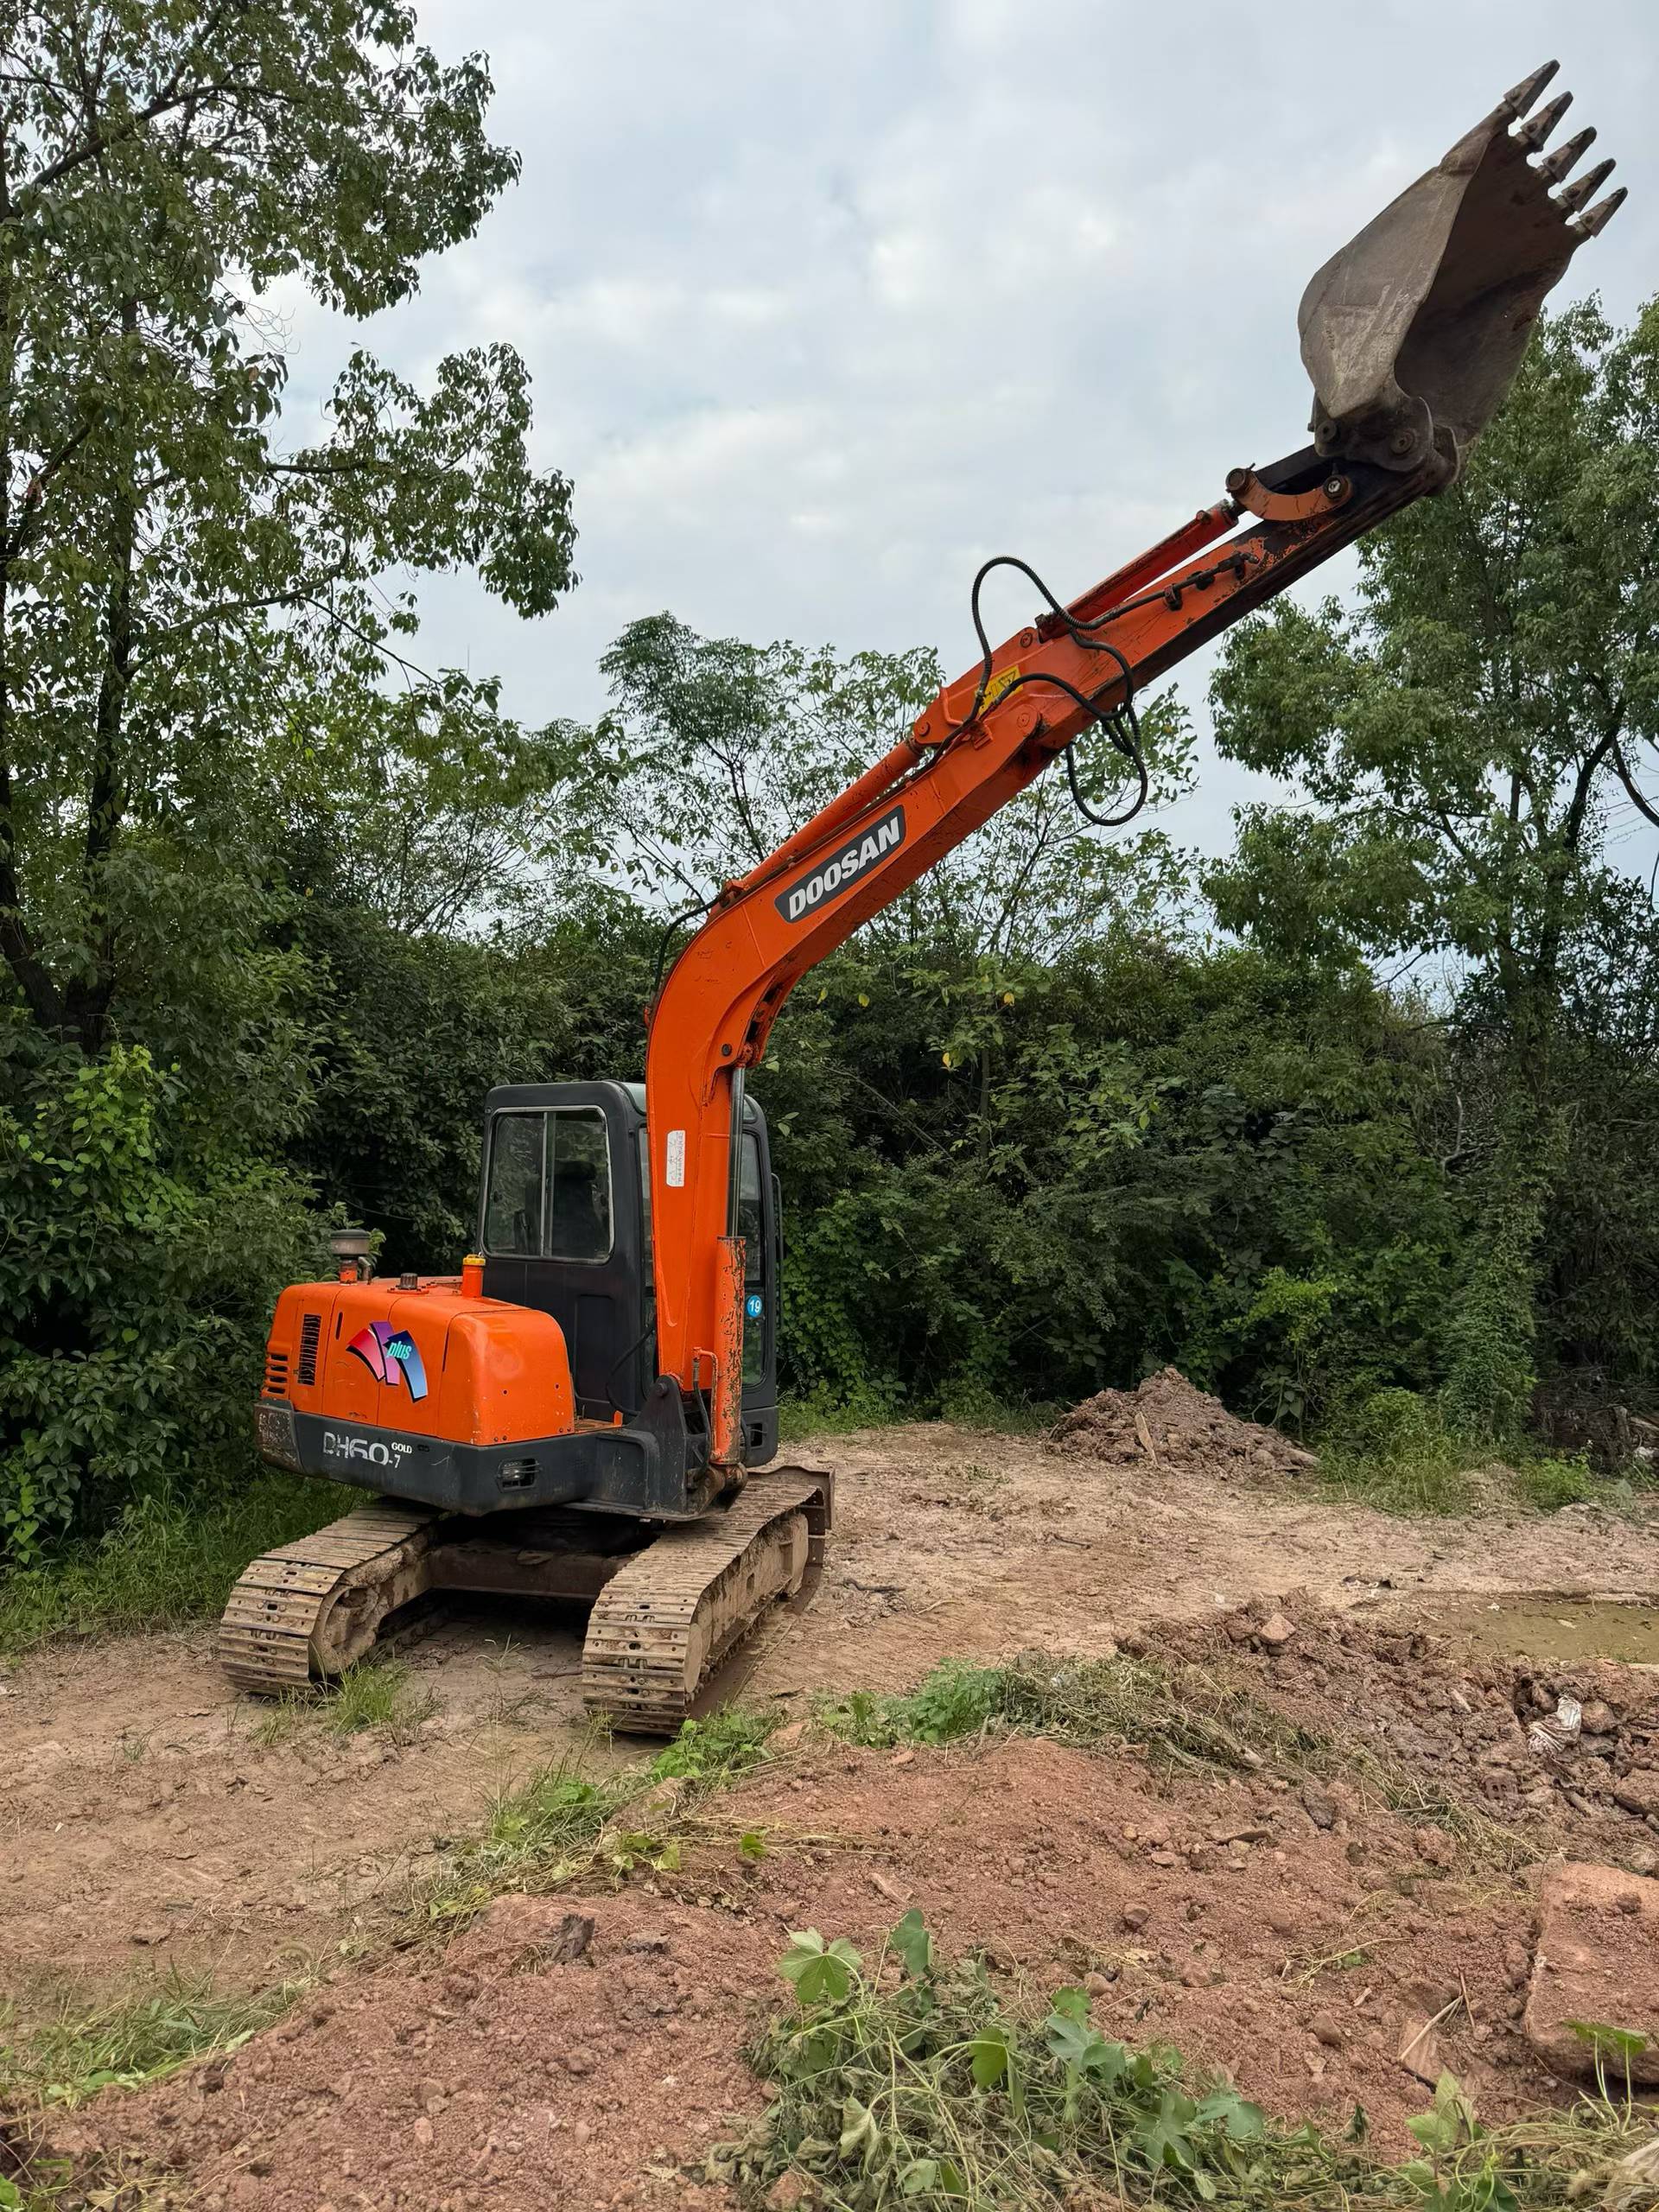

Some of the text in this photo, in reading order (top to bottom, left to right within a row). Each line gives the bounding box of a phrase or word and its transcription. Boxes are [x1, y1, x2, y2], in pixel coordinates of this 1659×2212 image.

[788, 816, 900, 920] DOOSAN
[749, 1300, 761, 1313] 19
[385, 1340, 412, 1360] plus
[391, 1441, 413, 1454] GOLD
